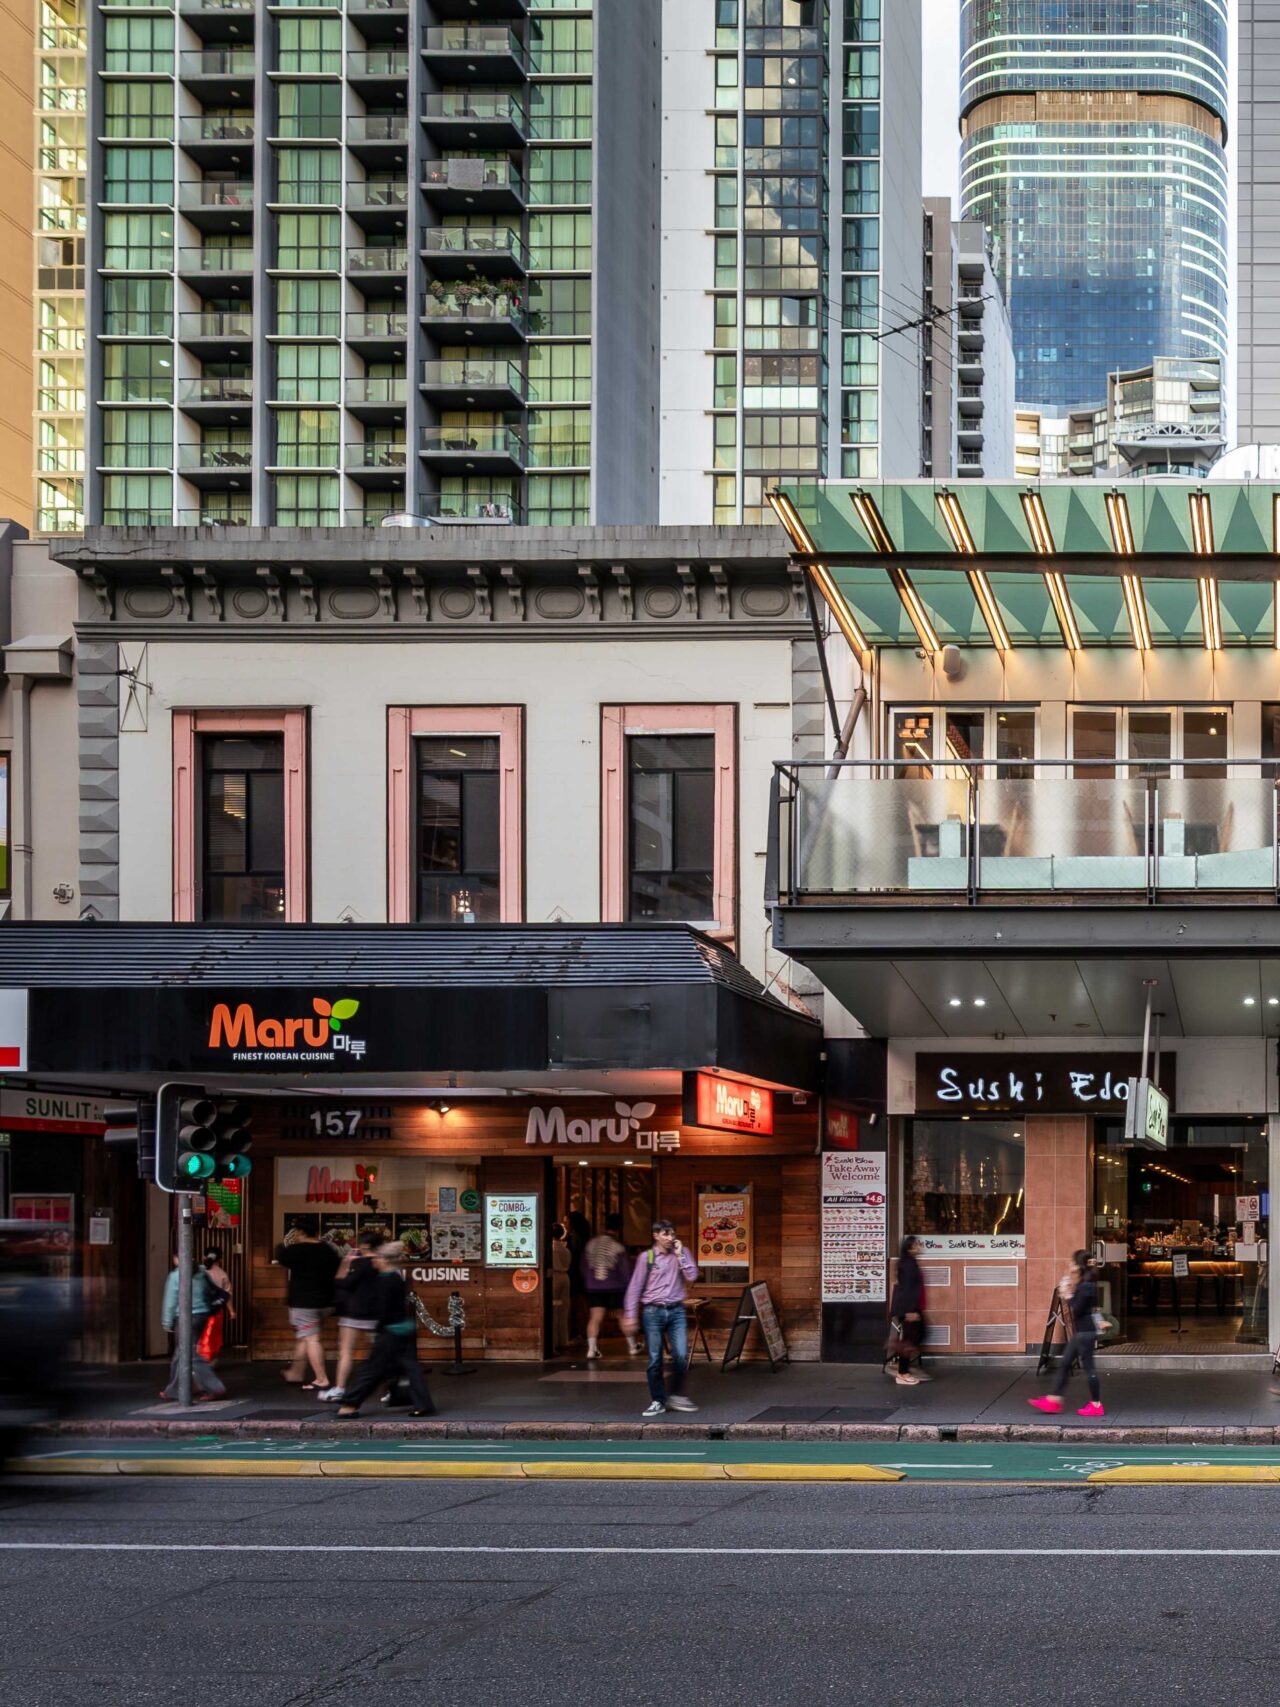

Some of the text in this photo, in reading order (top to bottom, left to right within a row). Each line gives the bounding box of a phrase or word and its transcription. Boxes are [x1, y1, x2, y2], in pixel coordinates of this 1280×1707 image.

[209, 1003, 329, 1048] Maru
[233, 1052, 335, 1061] FINEST KOREAN CUISINE
[333, 1034, 366, 1061] 마루
[936, 1067, 1130, 1102] Sushi Edo
[26, 1097, 91, 1119] SUNLIT
[716, 1083, 744, 1118] Maru
[310, 1110, 362, 1137] 157
[525, 1106, 630, 1145] Maru
[636, 1130, 681, 1153] 마루
[827, 1164, 881, 1174] Take Away
[831, 1172, 881, 1181] Welcome
[306, 1165, 365, 1205] Maru
[499, 1202, 525, 1213] COMBO
[411, 1267, 470, 1282] CUISINE
